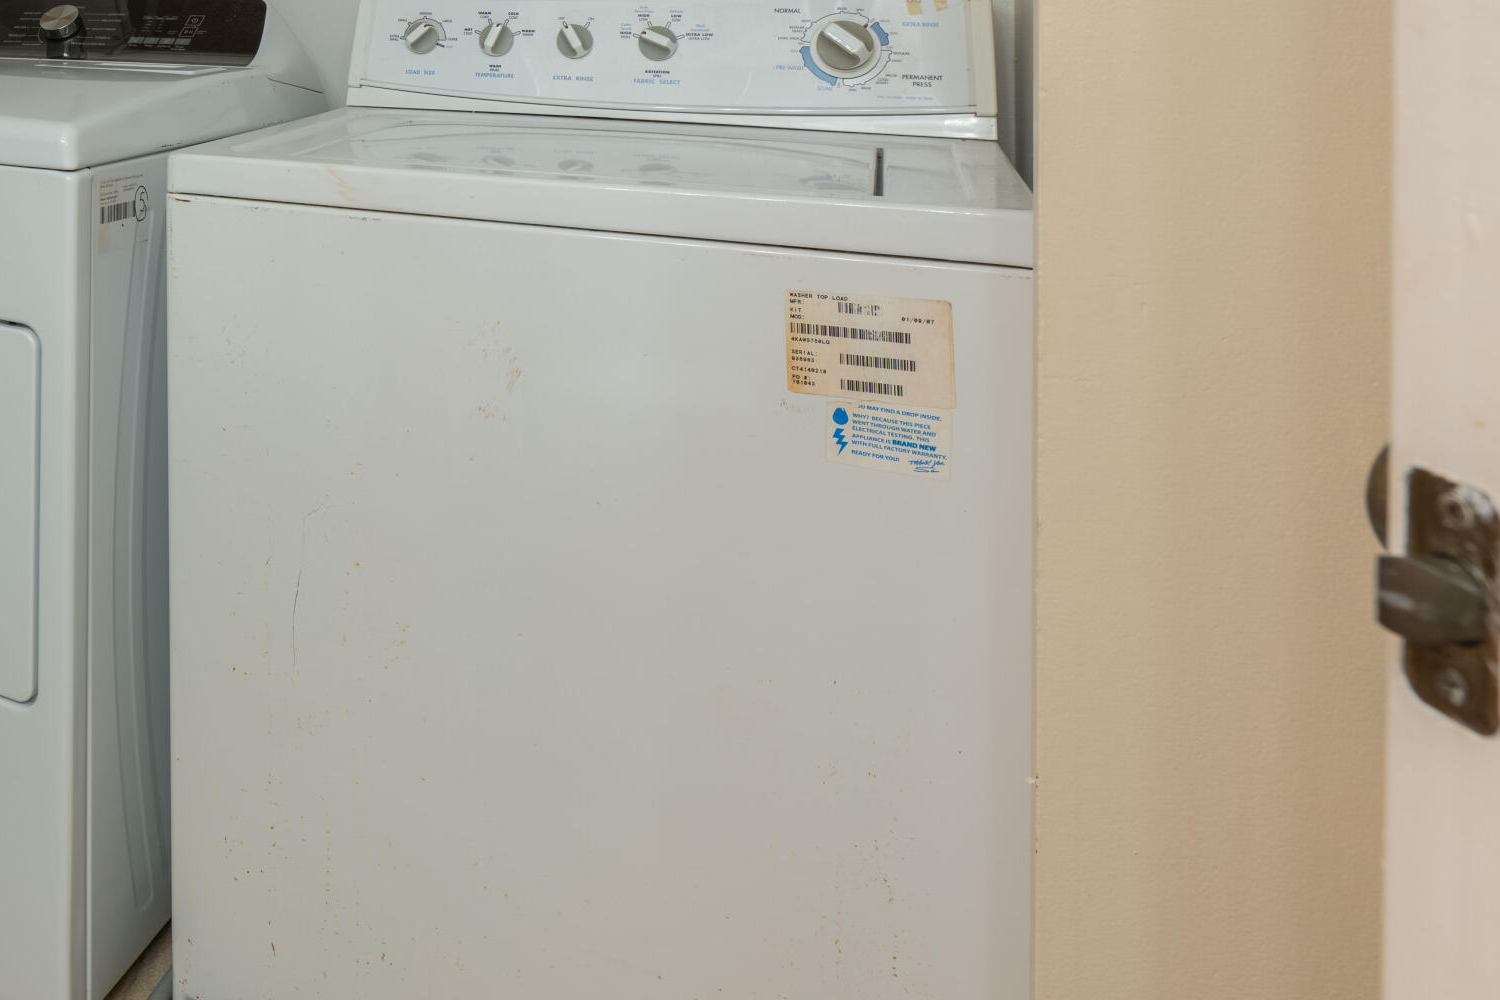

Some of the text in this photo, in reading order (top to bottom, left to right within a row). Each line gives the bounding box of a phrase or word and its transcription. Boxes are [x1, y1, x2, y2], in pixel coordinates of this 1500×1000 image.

[852, 419, 937, 438] WENT THROUGH WATER AND
[871, 416, 898, 425] BECAUSE
[914, 422, 931, 430] PIECE
[852, 426, 887, 436] ELECTRICAL
[852, 433, 885, 444] APPLIANCE
[892, 439, 919, 449] BRAND
[919, 444, 937, 452] NEW
[867, 442, 883, 450] FULL
[884, 445, 911, 454] FACTORY
[851, 449, 871, 457] READY
